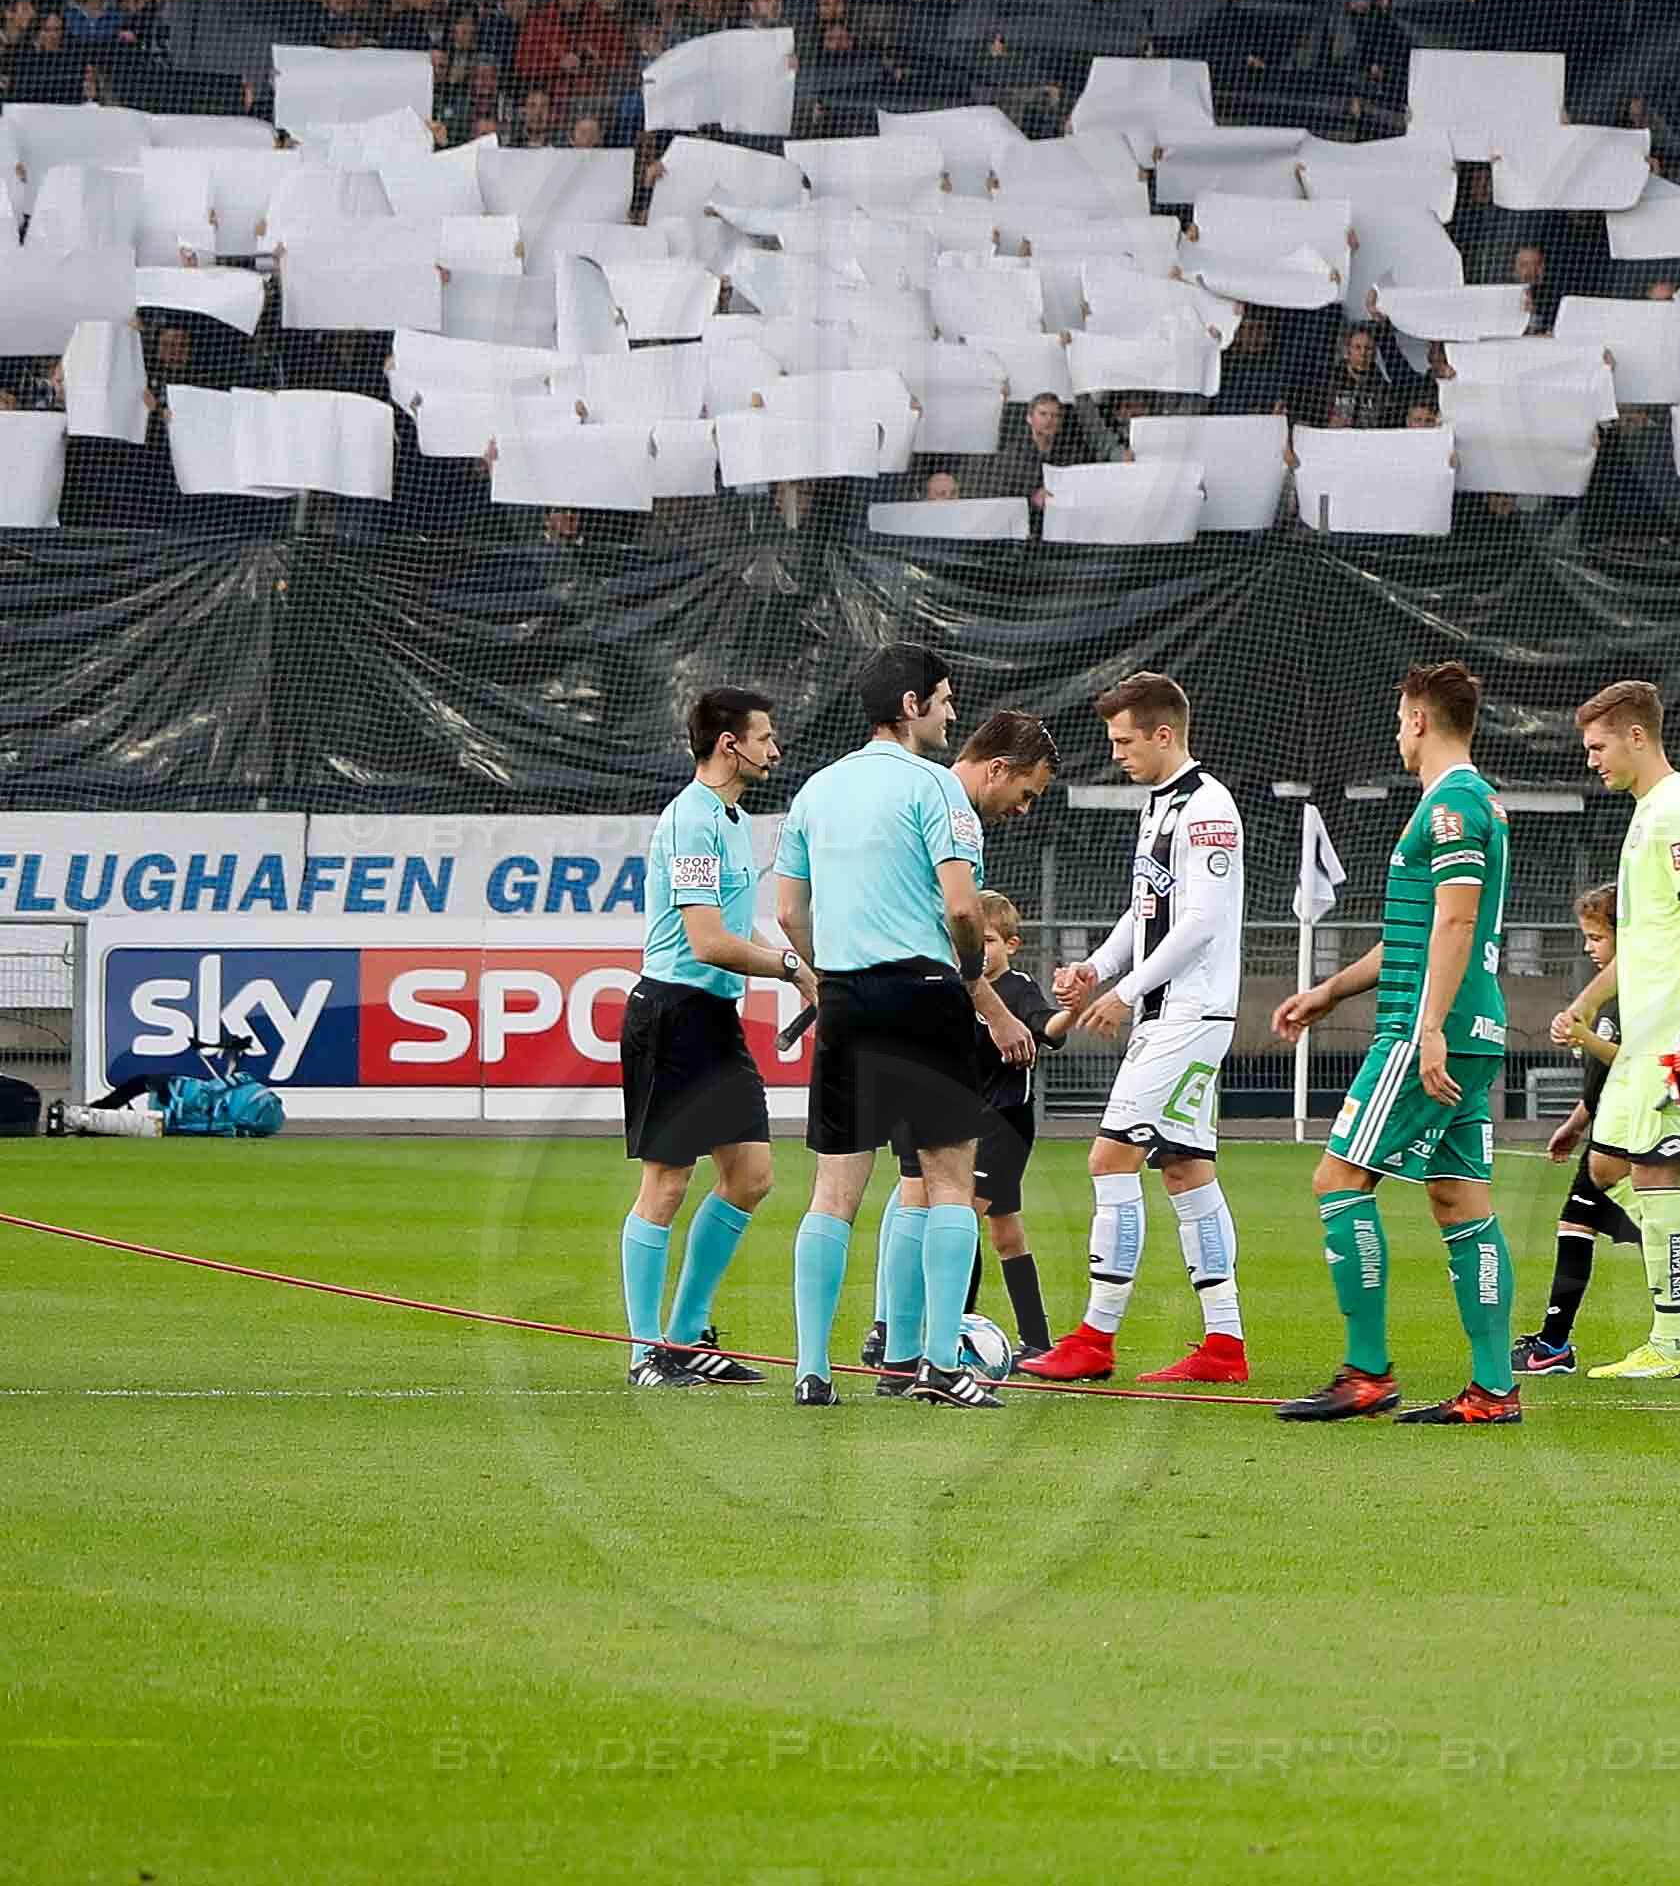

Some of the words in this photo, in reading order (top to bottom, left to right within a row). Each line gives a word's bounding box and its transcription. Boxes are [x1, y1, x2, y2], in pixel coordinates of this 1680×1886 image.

[674, 857, 718, 868] SPORT
[680, 867, 712, 877] OHNE
[674, 875, 717, 885] DOPING
[131, 954, 334, 1082] sky
[388, 968, 808, 1065] SPOT
